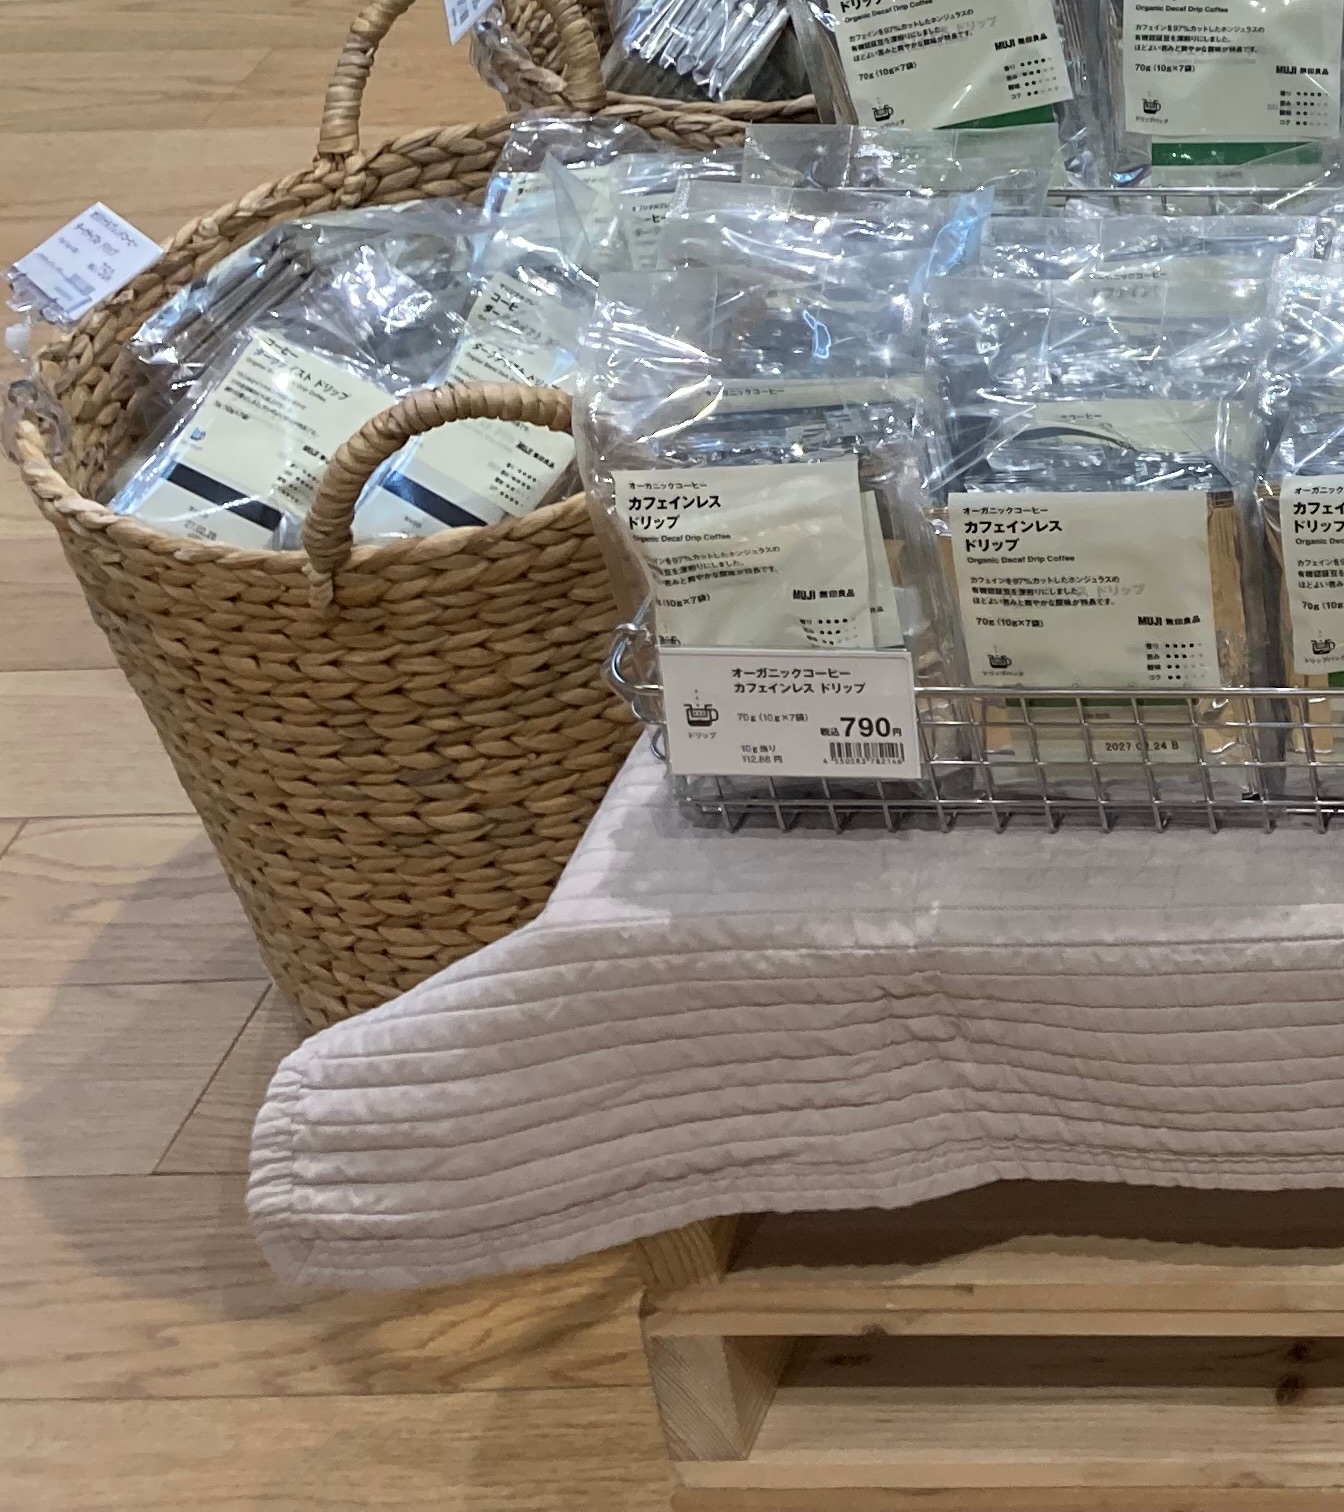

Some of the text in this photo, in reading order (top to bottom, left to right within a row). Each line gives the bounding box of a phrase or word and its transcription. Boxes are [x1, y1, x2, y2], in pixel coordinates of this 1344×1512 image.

[1276, 66, 1297, 75] MUJI
[628, 495, 721, 511] カフェインレス
[963, 507, 1048, 515] オーガニックコーヒー
[629, 515, 680, 530] ドリップ
[964, 520, 1063, 534] カフェインレス
[965, 538, 1020, 552] ドリップ
[793, 589, 816, 600] MUJI
[732, 668, 851, 678] オーガニックコーヒー
[734, 682, 865, 694] カフェインレス ドリップ
